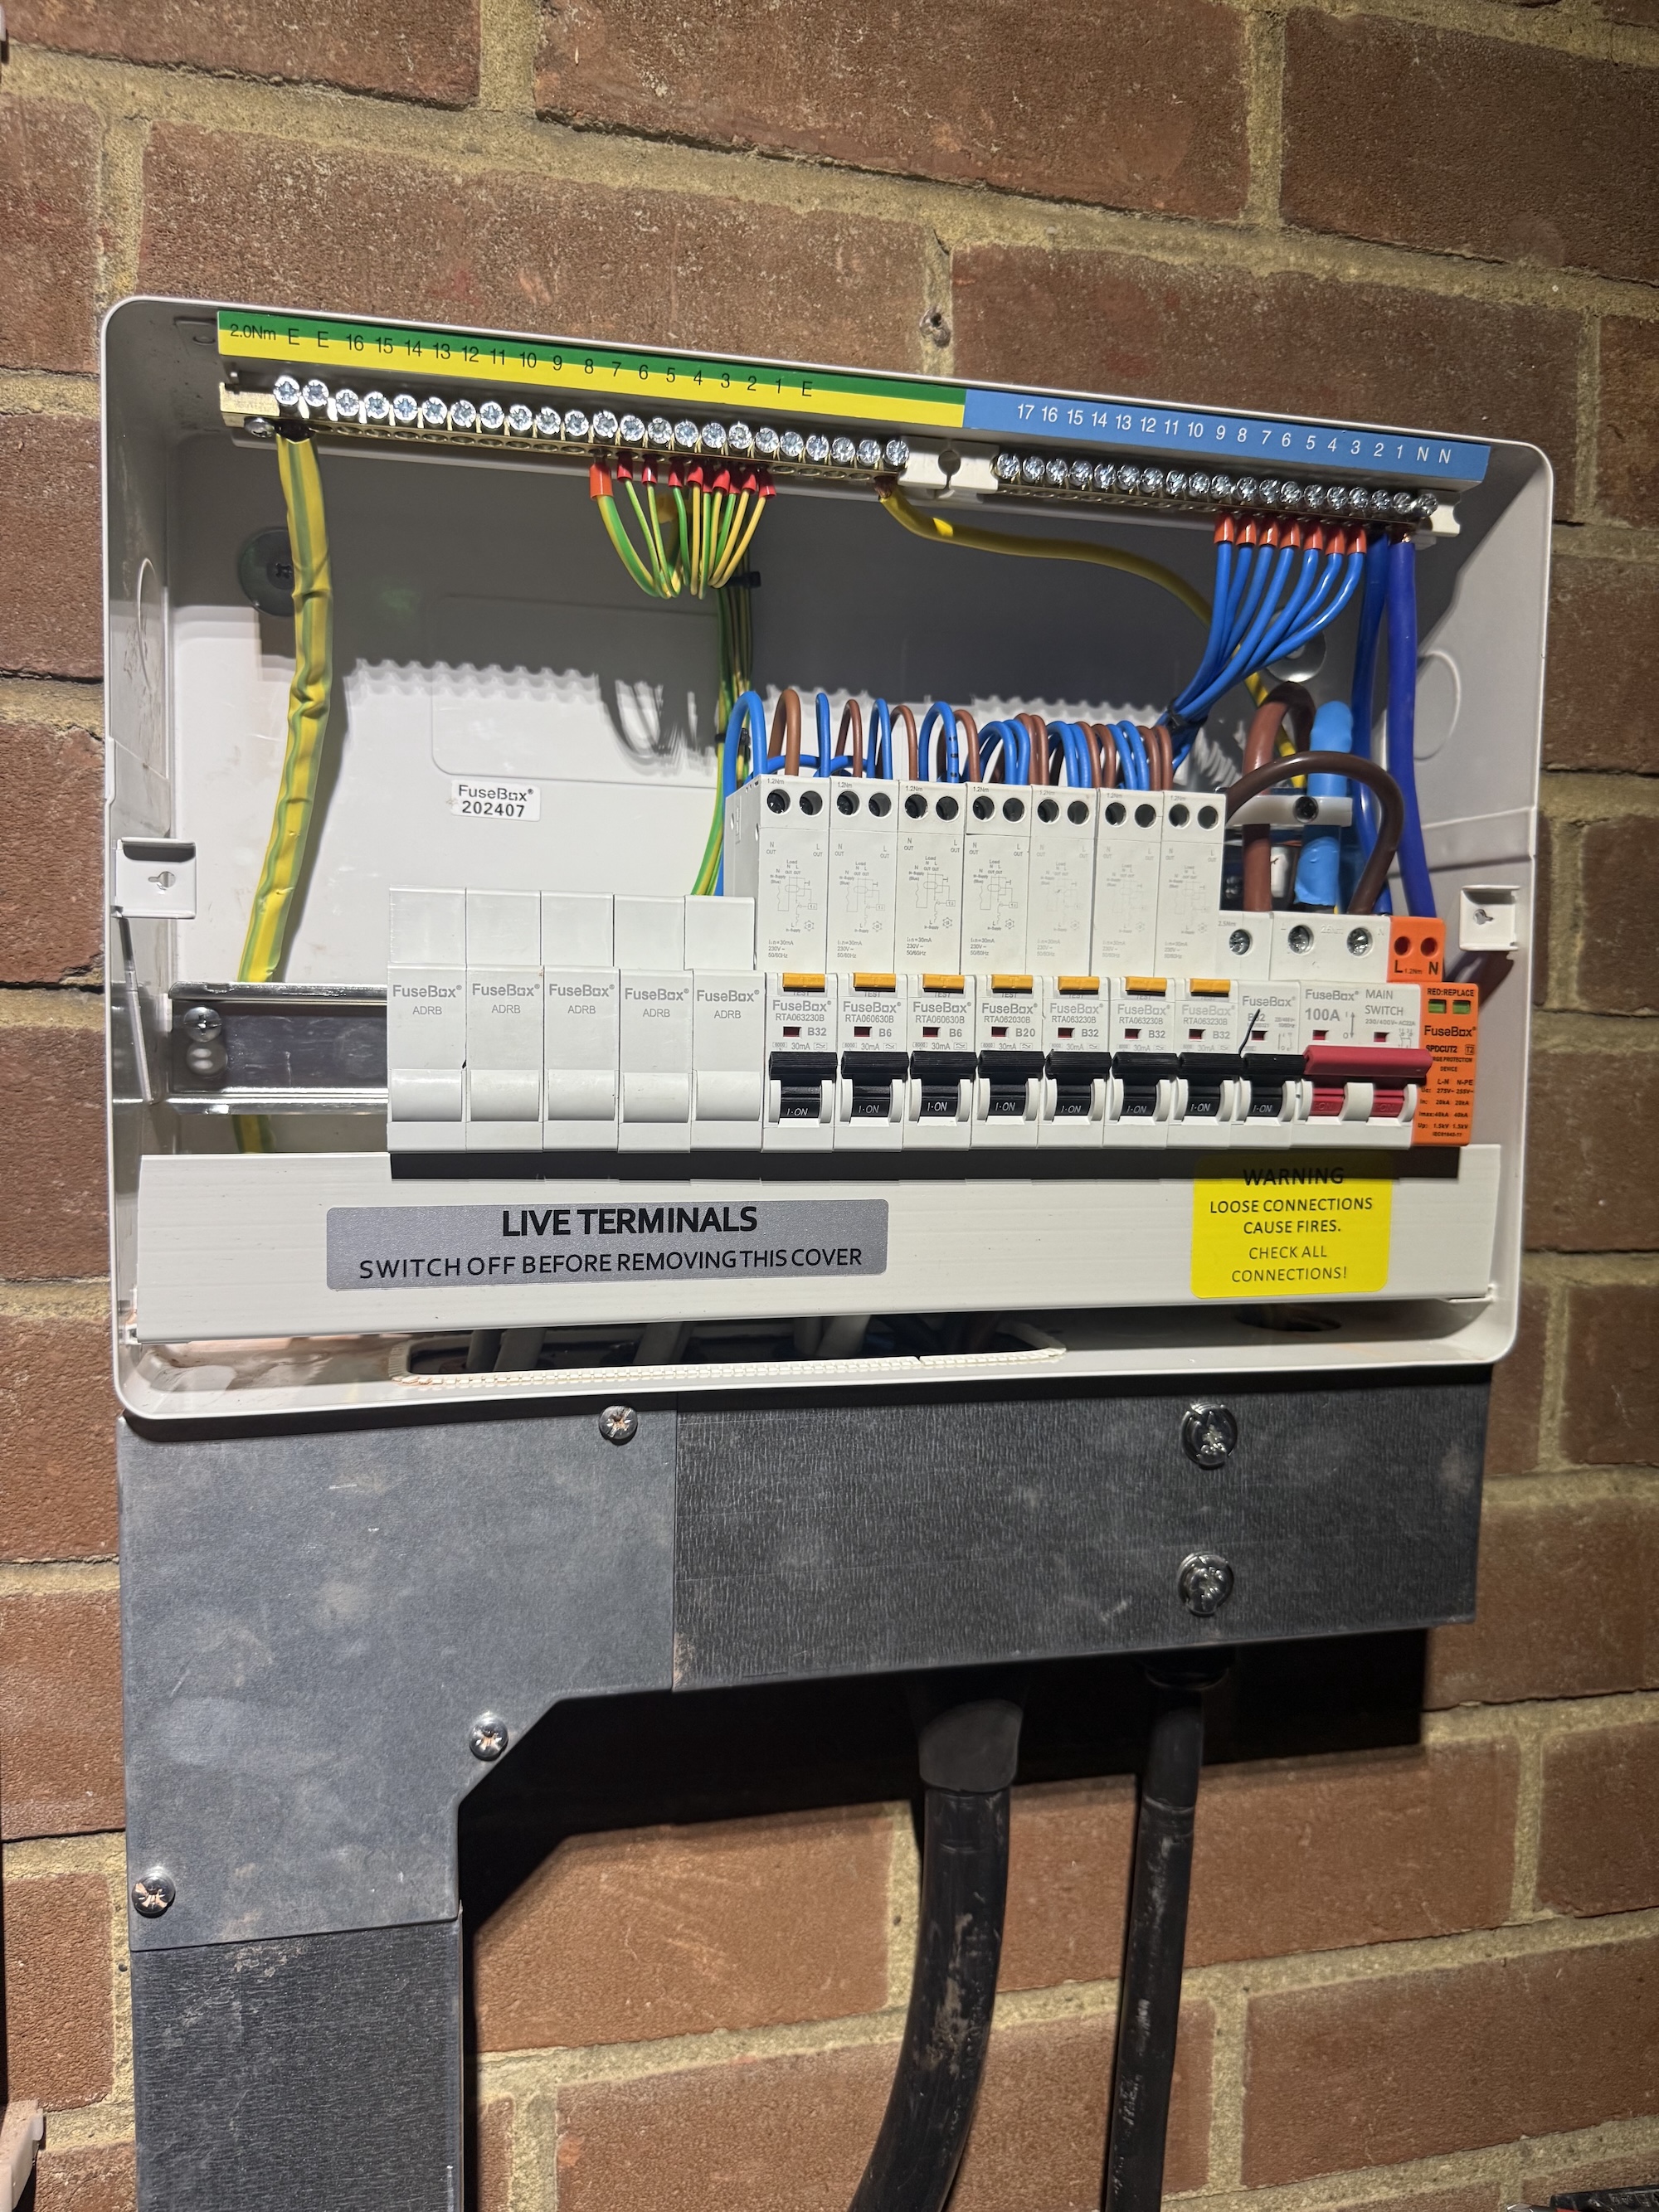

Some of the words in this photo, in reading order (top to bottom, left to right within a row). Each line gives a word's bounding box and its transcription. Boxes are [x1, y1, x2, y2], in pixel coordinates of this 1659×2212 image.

[231, 324, 276, 341] 2.0Nm
[289, 328, 299, 345] E
[318, 331, 328, 348] E
[347, 335, 364, 351] 16
[376, 338, 393, 353] 15
[405, 340, 422, 357] 14
[433, 343, 450, 359] 13
[462, 347, 479, 362] 12
[491, 349, 506, 365] 11
[520, 352, 537, 368] 10
[553, 356, 562, 371] 9
[585, 359, 593, 374] 8
[612, 362, 621, 377] 7
[639, 365, 649, 380] 6
[666, 367, 675, 382] 5
[693, 371, 703, 386] 4
[722, 373, 730, 388] 3
[747, 377, 757, 391] 2
[776, 380, 781, 394] 1
[802, 382, 812, 396] E
[1018, 404, 1034, 420] 17
[1041, 406, 1058, 422] 16
[1067, 410, 1083, 425] 15
[1092, 412, 1107, 427] 14
[1116, 415, 1131, 430] 13
[1141, 417, 1155, 432] 12
[1164, 420, 1179, 435] 11
[1188, 422, 1203, 438] 10
[1216, 425, 1224, 440] 9
[1238, 428, 1246, 443] 8
[1261, 430, 1271, 445] 7
[1282, 433, 1291, 448] 6
[1306, 435, 1315, 450] 5
[1327, 438, 1336, 452] 4
[1351, 440, 1360, 455] 3
[1374, 443, 1384, 457] 2
[1398, 445, 1402, 459] 1
[1418, 447, 1428, 461] N
[1439, 449, 1450, 464] N
[462, 801, 524, 817] 202407
[1395, 960, 1403, 973] L
[1428, 962, 1438, 975] N
[1366, 989, 1393, 999] MAIN
[1428, 989, 1474, 997] RED:REPLACE
[412, 1005, 442, 1015] ADRB
[492, 1004, 521, 1014] ADRB
[568, 1005, 596, 1014] ADRB
[643, 1009, 670, 1018] ADRB
[714, 1009, 742, 1018] ADRB
[1306, 1008, 1340, 1021] 100A
[1365, 1005, 1404, 1016] SWITCH
[776, 1014, 825, 1022] RTA063230B
[916, 1015, 965, 1023] RTA060630B
[808, 1028, 826, 1036] B32
[1016, 1028, 1035, 1037] B20
[1149, 1030, 1165, 1038] B32
[1243, 1167, 1344, 1186] WARNING
[1210, 1201, 1258, 1213] LOOSE
[1263, 1198, 1372, 1212] CONNECTIONS
[502, 1209, 572, 1237] LIVE
[577, 1206, 757, 1235] TERMINALS
[1243, 1222, 1292, 1234] CAUSE
[1297, 1220, 1340, 1232] FIRES.
[1249, 1247, 1297, 1259] CHECK
[1301, 1246, 1326, 1257] ALL
[359, 1258, 460, 1280] SWITCH
[467, 1257, 516, 1276] OFF
[522, 1254, 611, 1274] BEFORE
[618, 1251, 737, 1271] REMOVING
[740, 1249, 787, 1268] THIS
[791, 1248, 862, 1266] COVER
[1232, 1266, 1346, 1282] CONNECTIONS!
